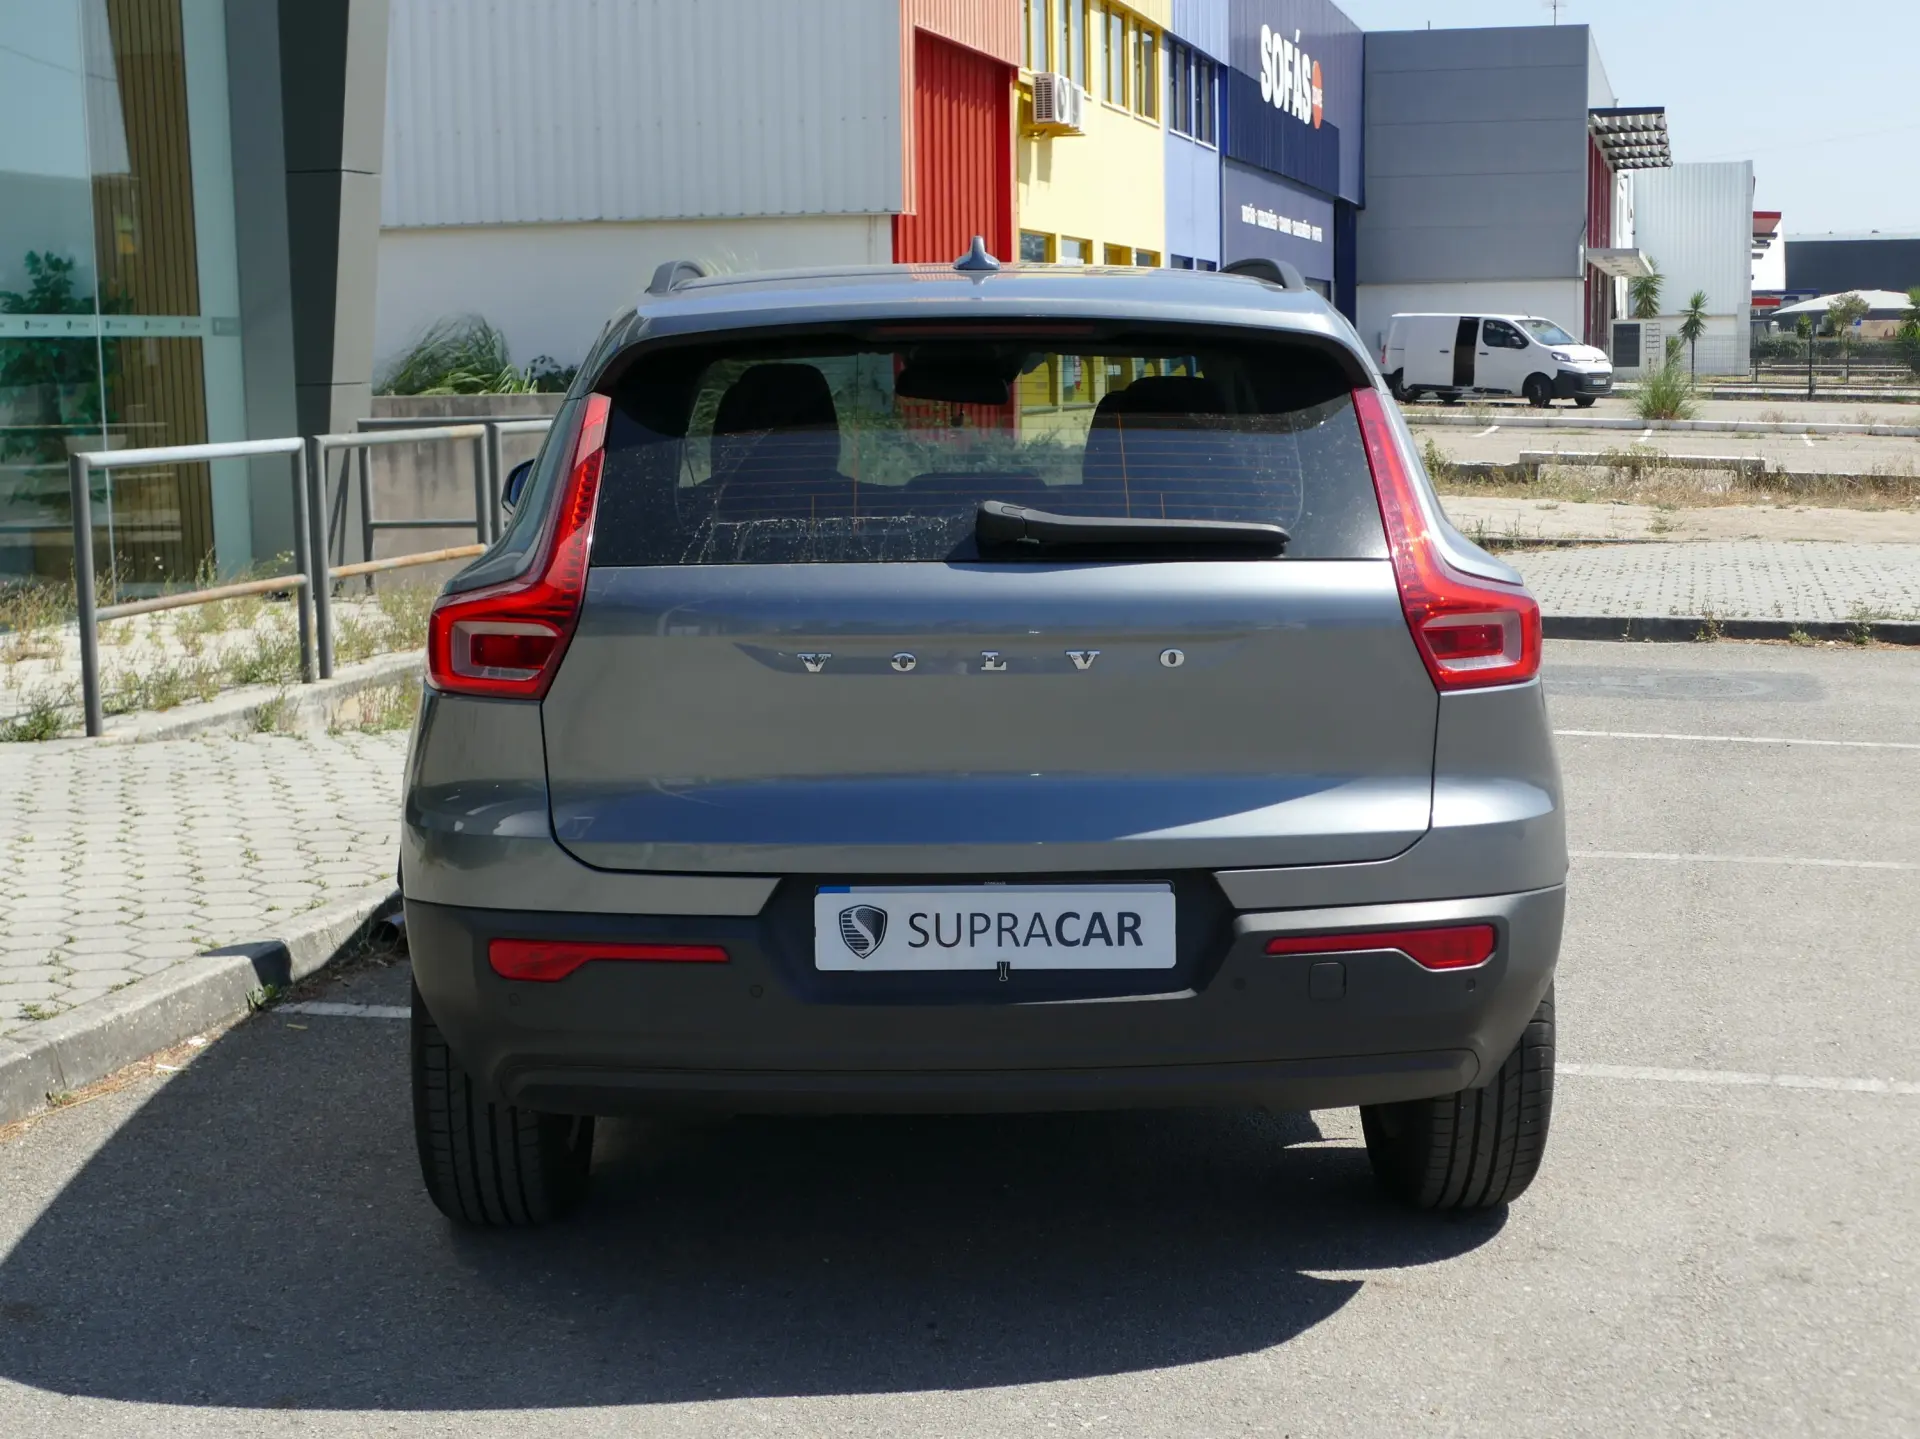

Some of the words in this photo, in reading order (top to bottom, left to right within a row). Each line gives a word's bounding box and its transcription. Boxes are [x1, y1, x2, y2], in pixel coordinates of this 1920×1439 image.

[1261, 23, 1311, 124] SOFÁS
[797, 648, 1185, 672] VOLVO
[907, 910, 1144, 949] SUPRACAR
